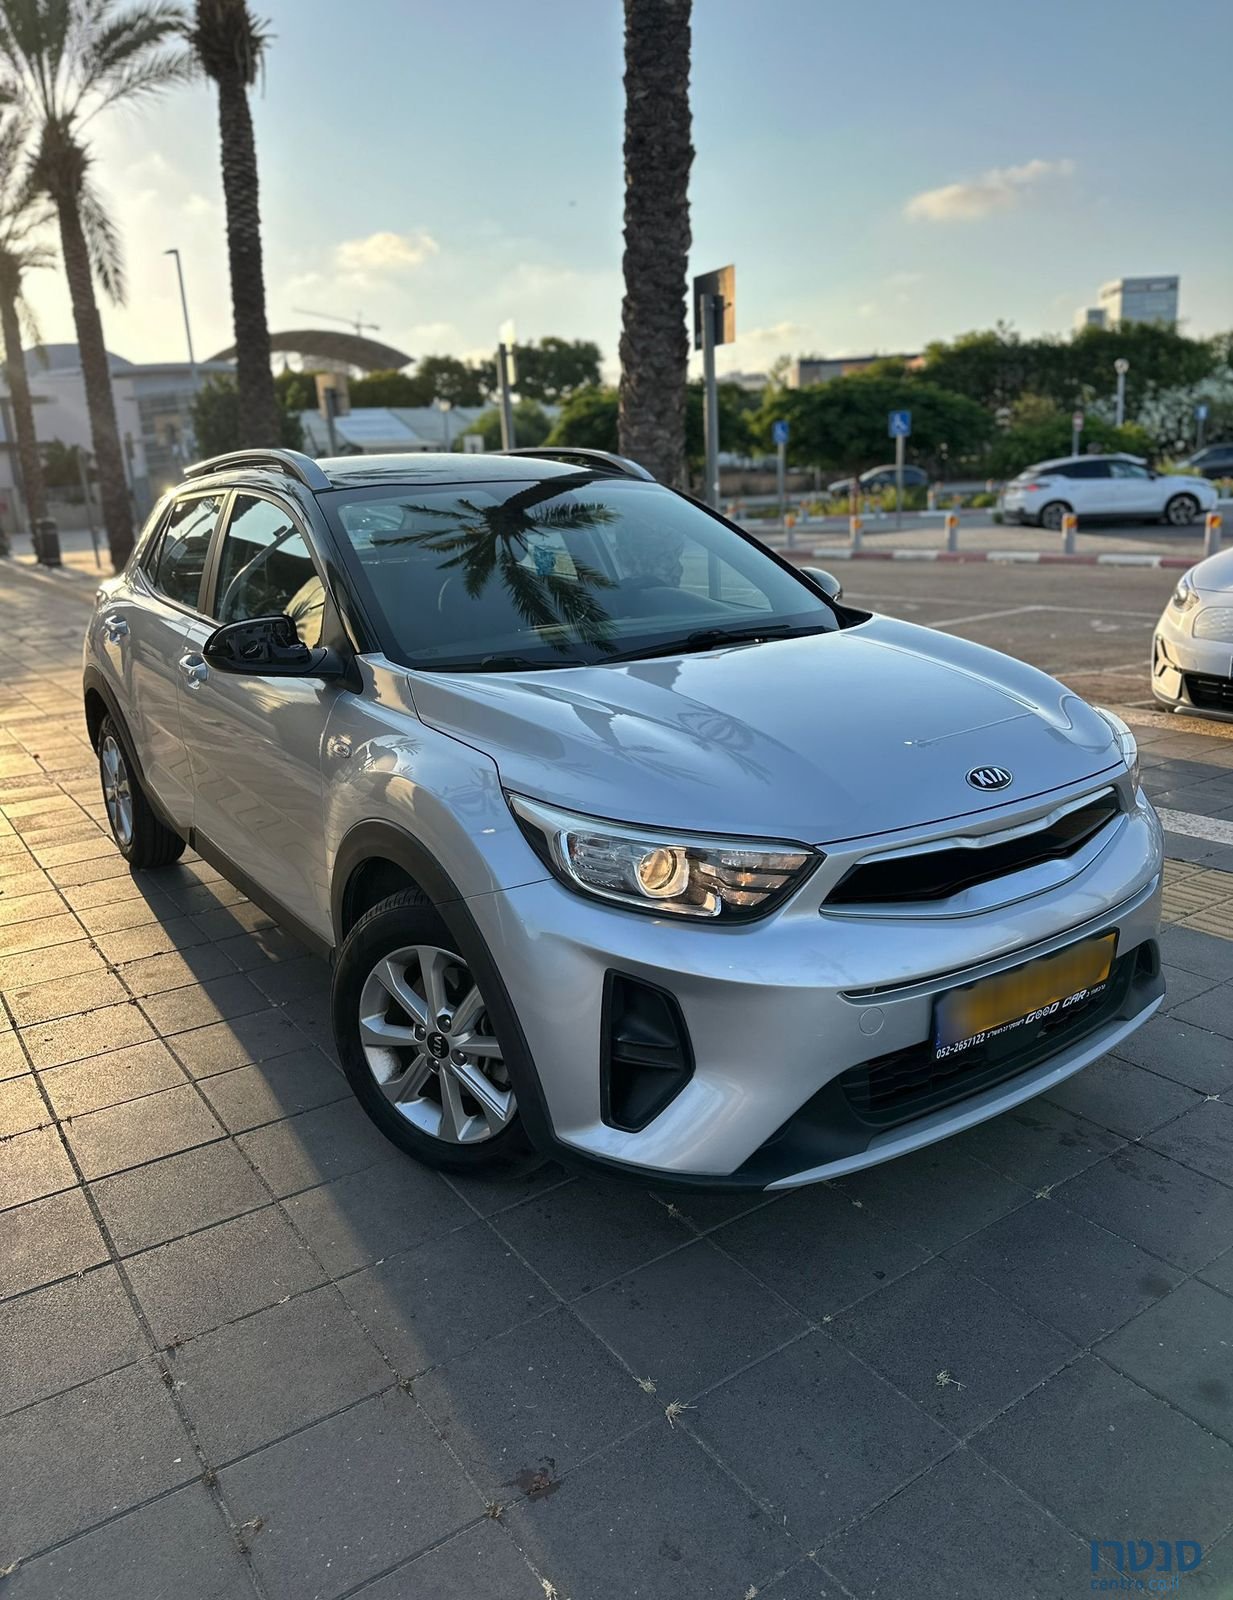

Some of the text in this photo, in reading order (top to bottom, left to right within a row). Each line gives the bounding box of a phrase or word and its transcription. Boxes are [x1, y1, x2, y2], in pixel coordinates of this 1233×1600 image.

[972, 767, 1010, 786] KIA
[1025, 1001, 1060, 1024] GOOD
[1062, 989, 1087, 1008] CAR
[936, 1032, 986, 1059] 052-2657122
